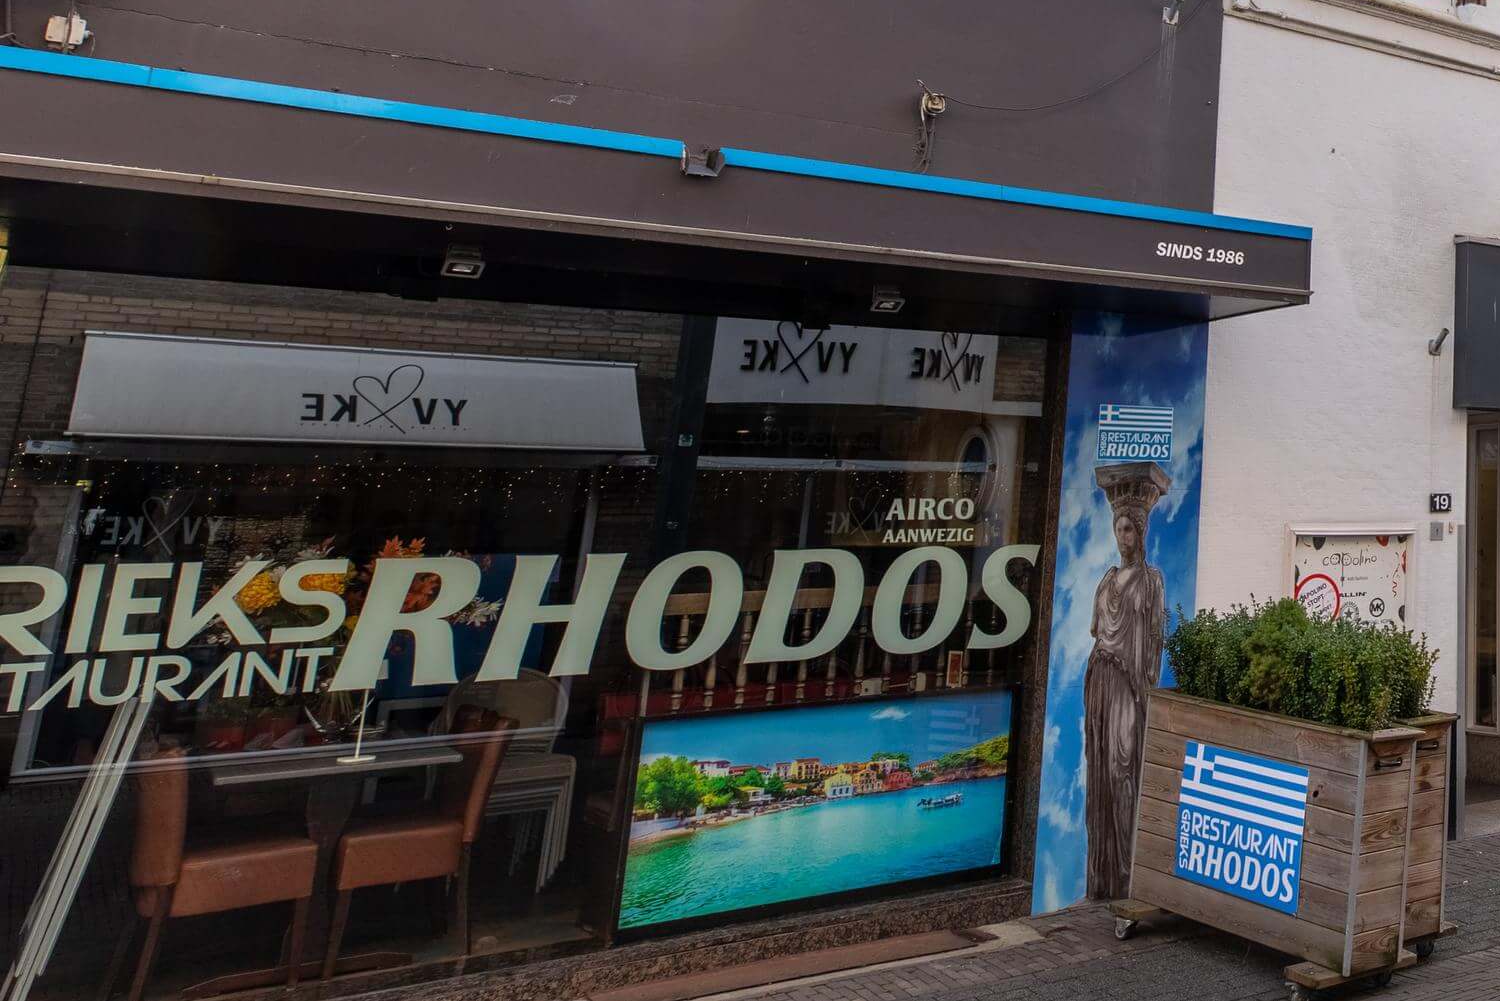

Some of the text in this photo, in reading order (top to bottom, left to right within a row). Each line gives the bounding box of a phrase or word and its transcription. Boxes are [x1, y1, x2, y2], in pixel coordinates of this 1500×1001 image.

[1156, 241, 1245, 265] SINDS 1986
[1107, 432, 1170, 444] RESTAURANT
[1106, 443, 1169, 458] RHODOS
[885, 498, 974, 521] AIRCO
[1433, 495, 1450, 510] 19
[882, 527, 974, 544] AANWEZIG
[327, 544, 1042, 692] RHODOS
[1179, 808, 1191, 869] GRIEKS
[1191, 812, 1298, 865] RESTAURANT
[1187, 839, 1296, 903] RHODOS
